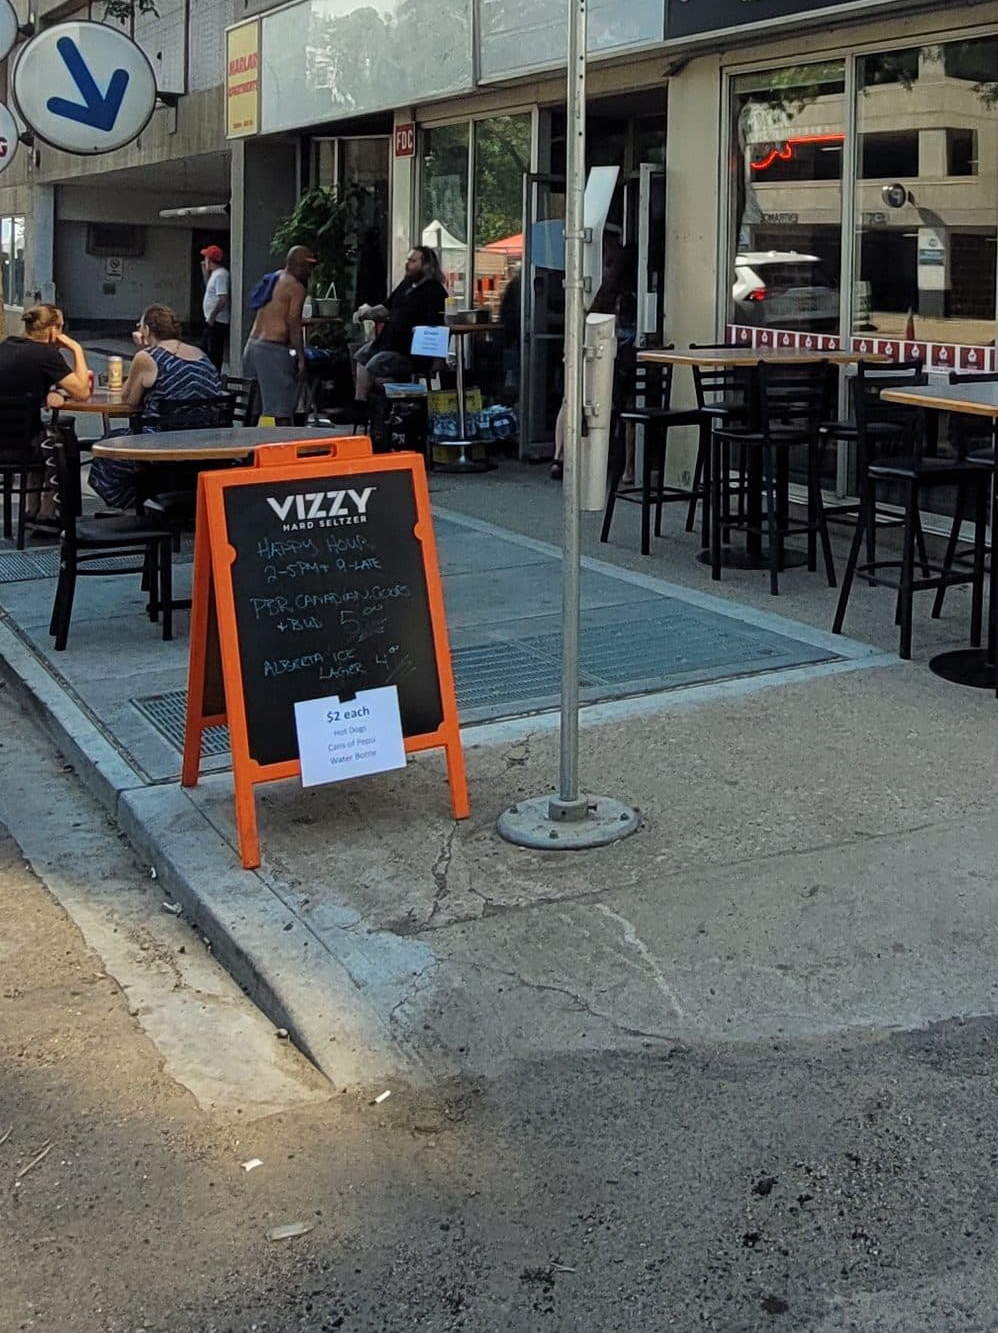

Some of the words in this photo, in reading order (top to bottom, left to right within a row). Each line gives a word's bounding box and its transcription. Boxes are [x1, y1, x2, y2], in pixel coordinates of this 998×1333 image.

[396, 129, 413, 151] FDC
[266, 487, 377, 521] VIZZY
[283, 521, 314, 532] HARD
[319, 516, 367, 528] SELTZER
[257, 537, 318, 559] HAPPY
[327, 534, 370, 553] HOUR
[264, 652, 325, 677] ALBERTA
[333, 648, 357, 662] ICE
[319, 662, 367, 680] LAGER
[327, 711, 341, 724] $2
[344, 706, 370, 719] each
[334, 728, 347, 737] Hot
[349, 725, 367, 735] Dogs
[328, 743, 346, 752] Cans
[357, 737, 376, 747] Pepsi
[330, 754, 353, 765] Water
[355, 749, 377, 760] Bottle
